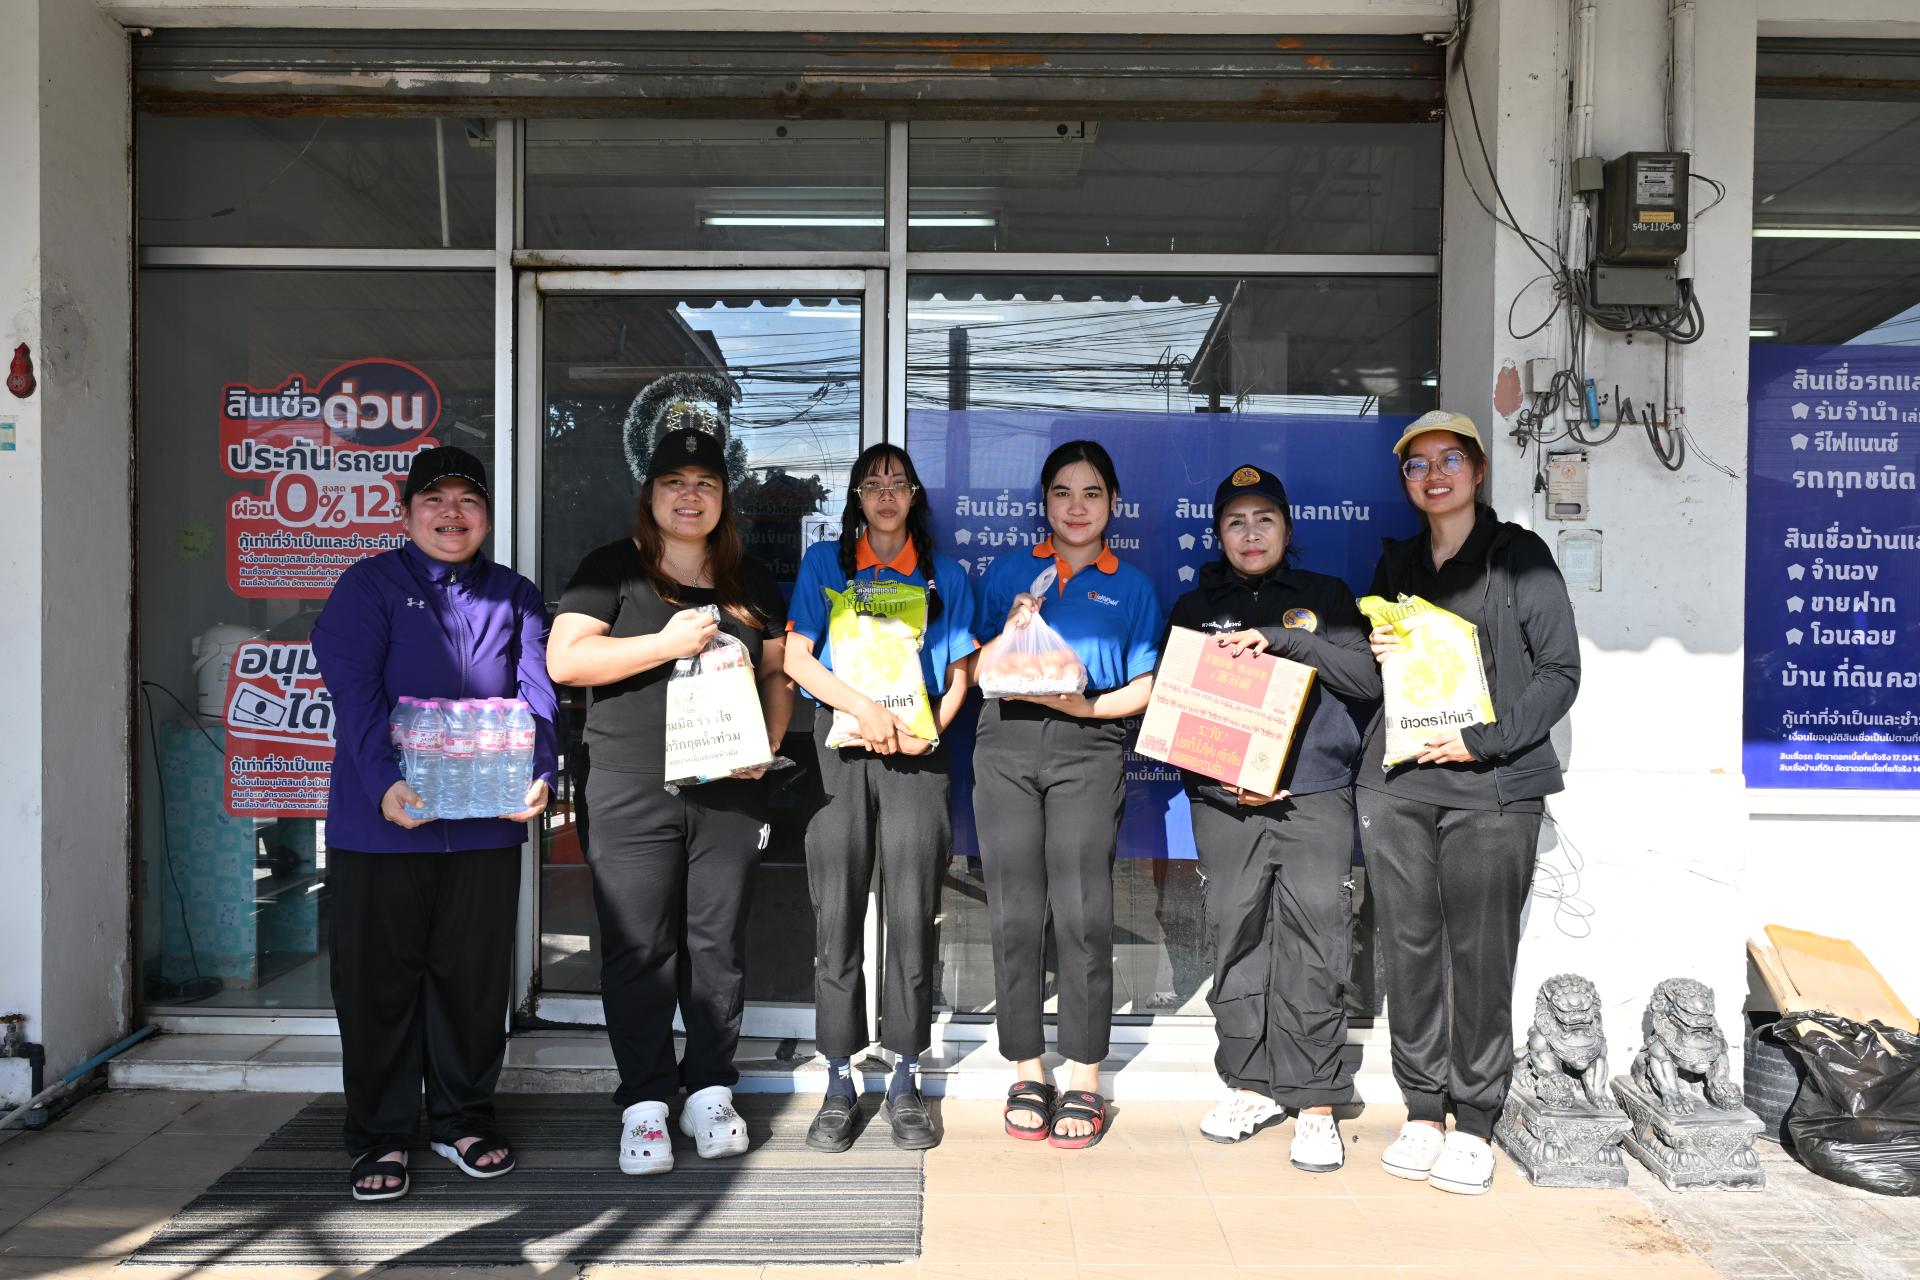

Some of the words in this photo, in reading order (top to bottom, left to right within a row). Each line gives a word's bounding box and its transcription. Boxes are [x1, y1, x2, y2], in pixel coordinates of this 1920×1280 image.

[227, 381, 320, 418] สินเชื่อ
[323, 382, 423, 430] ด่วน
[1814, 400, 1898, 421] รับจำนำ
[1814, 431, 1899, 452] รีไฟแนนซ์
[230, 439, 331, 471] ประกัน
[337, 446, 432, 473] รถยน
[1792, 465, 1917, 498] รถทุกชนิด
[234, 498, 275, 518] ผ่อน
[1811, 557, 1879, 581] จำนอง
[1811, 591, 1897, 613] ขายฝาก
[1810, 622, 1897, 646] โอนลอย
[1781, 661, 1827, 687] บ้าน
[1832, 657, 1883, 688] ที่ดิน
[1400, 709, 1474, 731] ข้าวตราไก่แจ้
